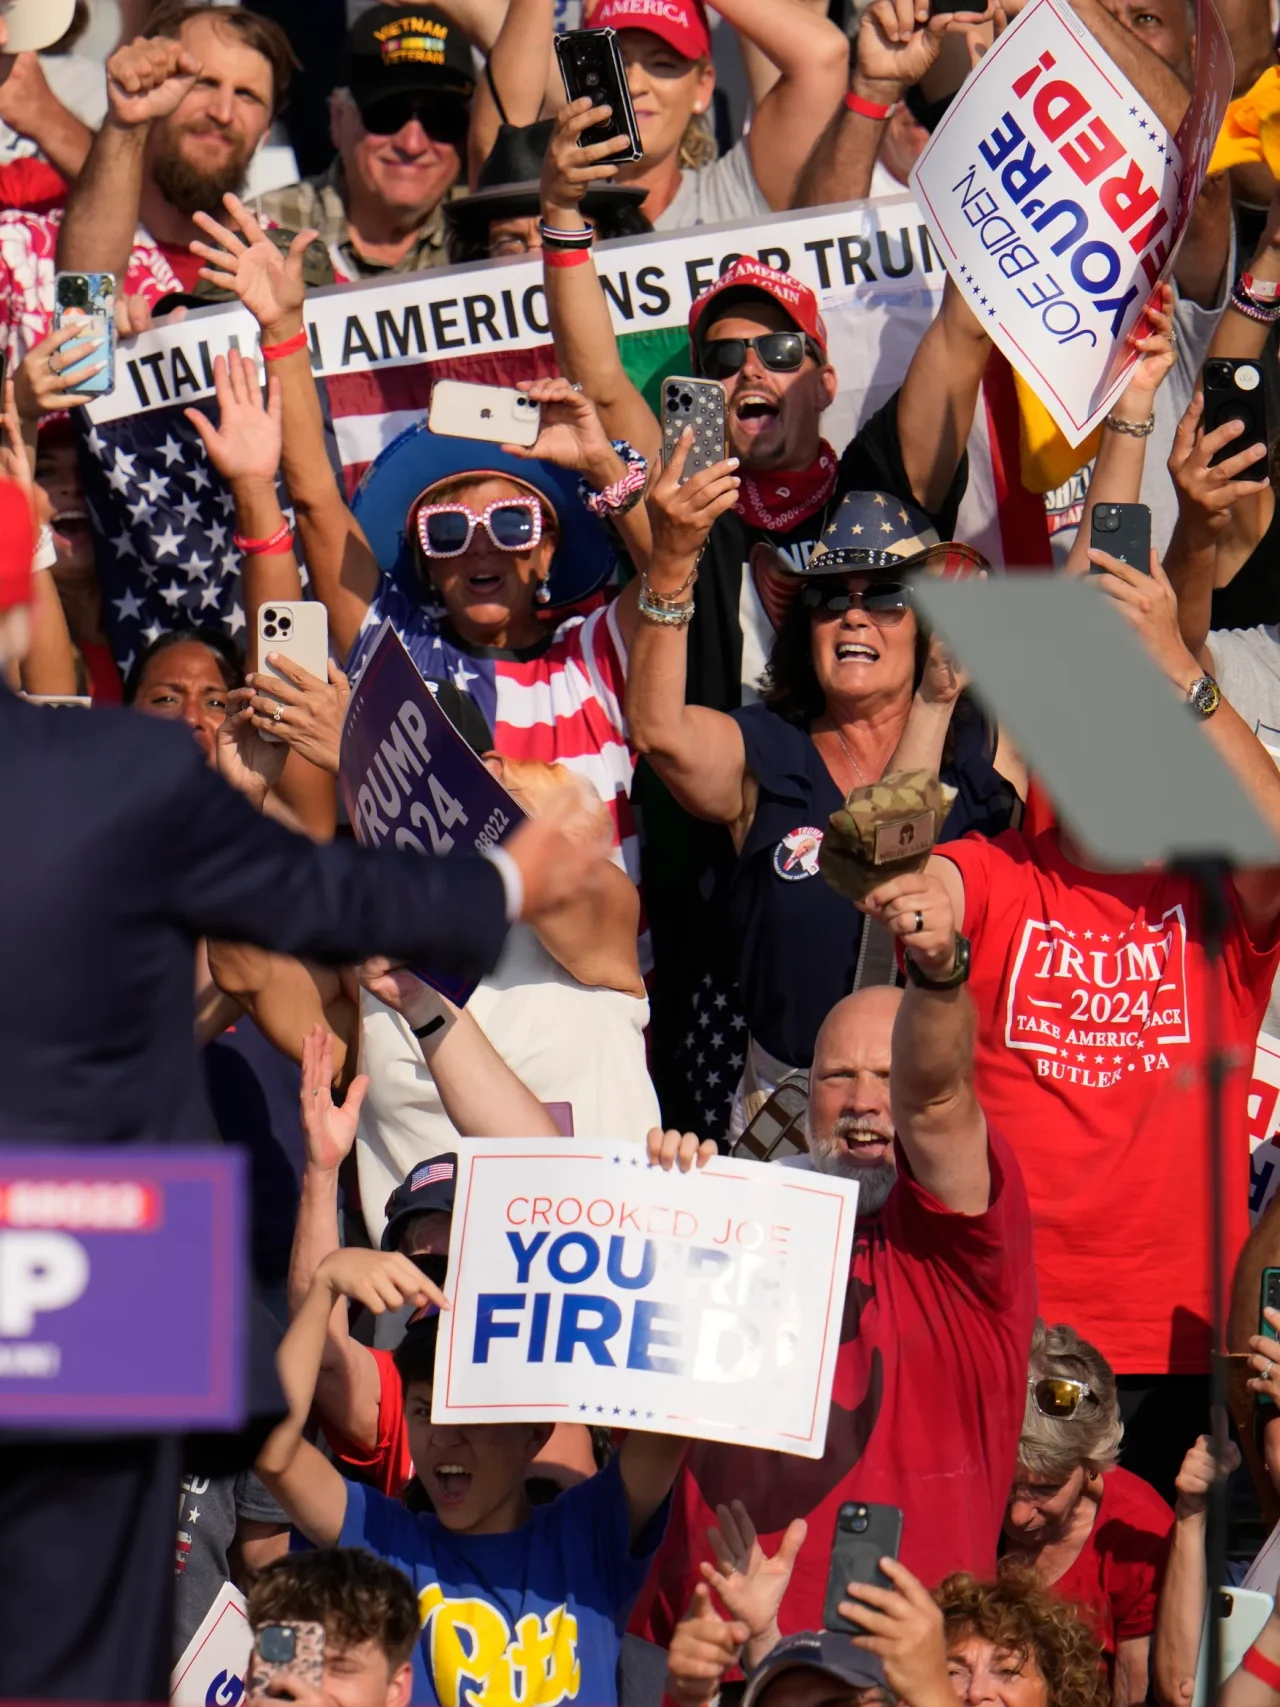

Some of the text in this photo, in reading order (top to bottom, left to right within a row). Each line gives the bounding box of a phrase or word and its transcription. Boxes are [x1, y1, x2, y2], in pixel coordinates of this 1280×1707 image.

[373, 16, 448, 42] VIETNAM
[381, 49, 446, 66] VETERAN
[977, 110, 1140, 340] YOU'RE
[952, 163, 1098, 348] JOE BIDEN,
[341, 264, 672, 367] AMERICNS
[797, 826, 824, 842] TRUMP
[1069, 988, 1150, 1024] 2024
[1016, 1014, 1062, 1040] TAKE
[1064, 1028, 1140, 1048] AMERIC
[1036, 1051, 1171, 1089] BUTLER PA
[505, 1196, 791, 1255] CROOKED JOE
